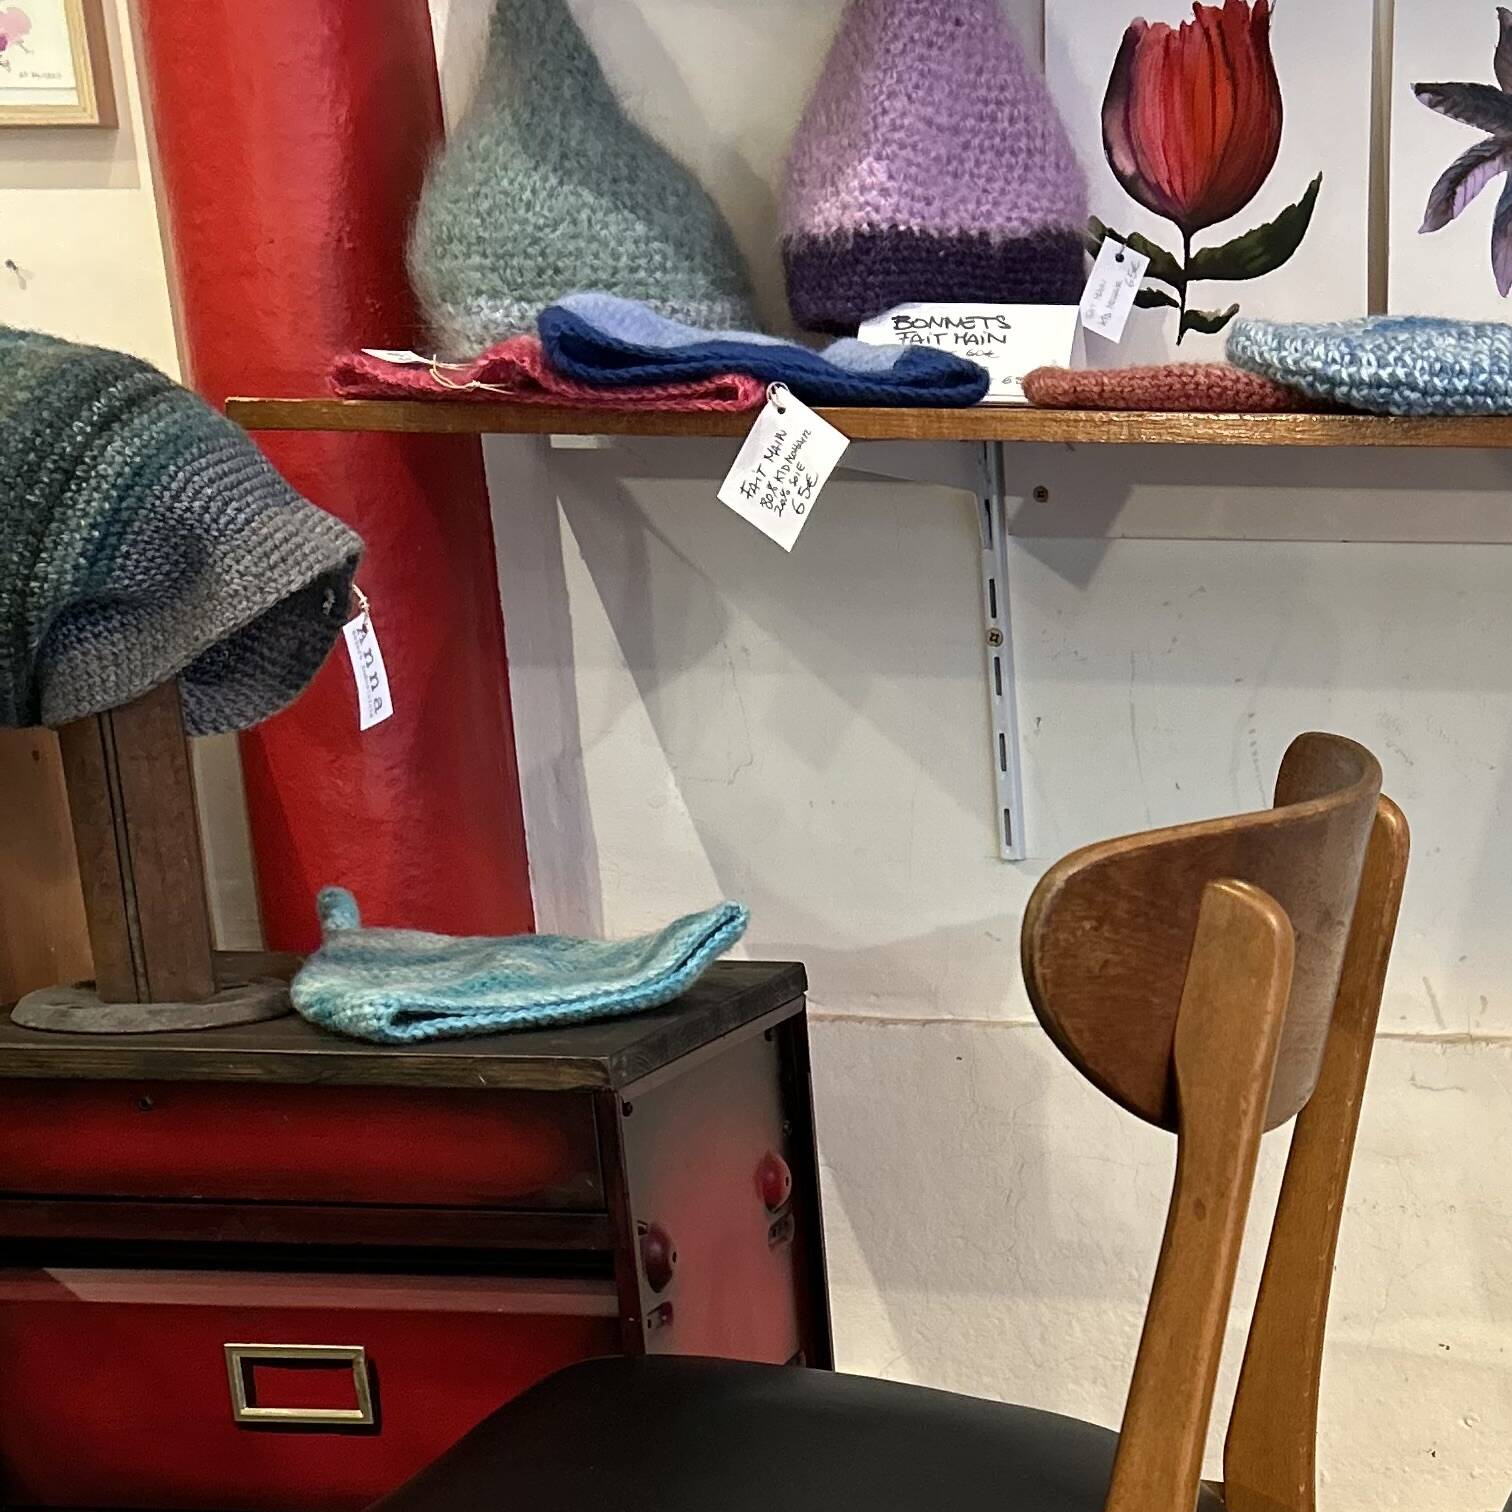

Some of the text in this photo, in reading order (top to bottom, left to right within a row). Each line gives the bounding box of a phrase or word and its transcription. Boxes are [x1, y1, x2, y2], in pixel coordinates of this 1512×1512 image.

[891, 315, 1012, 330] BONNETS
[773, 464, 791, 483] KID
[356, 623, 384, 716] Anna
